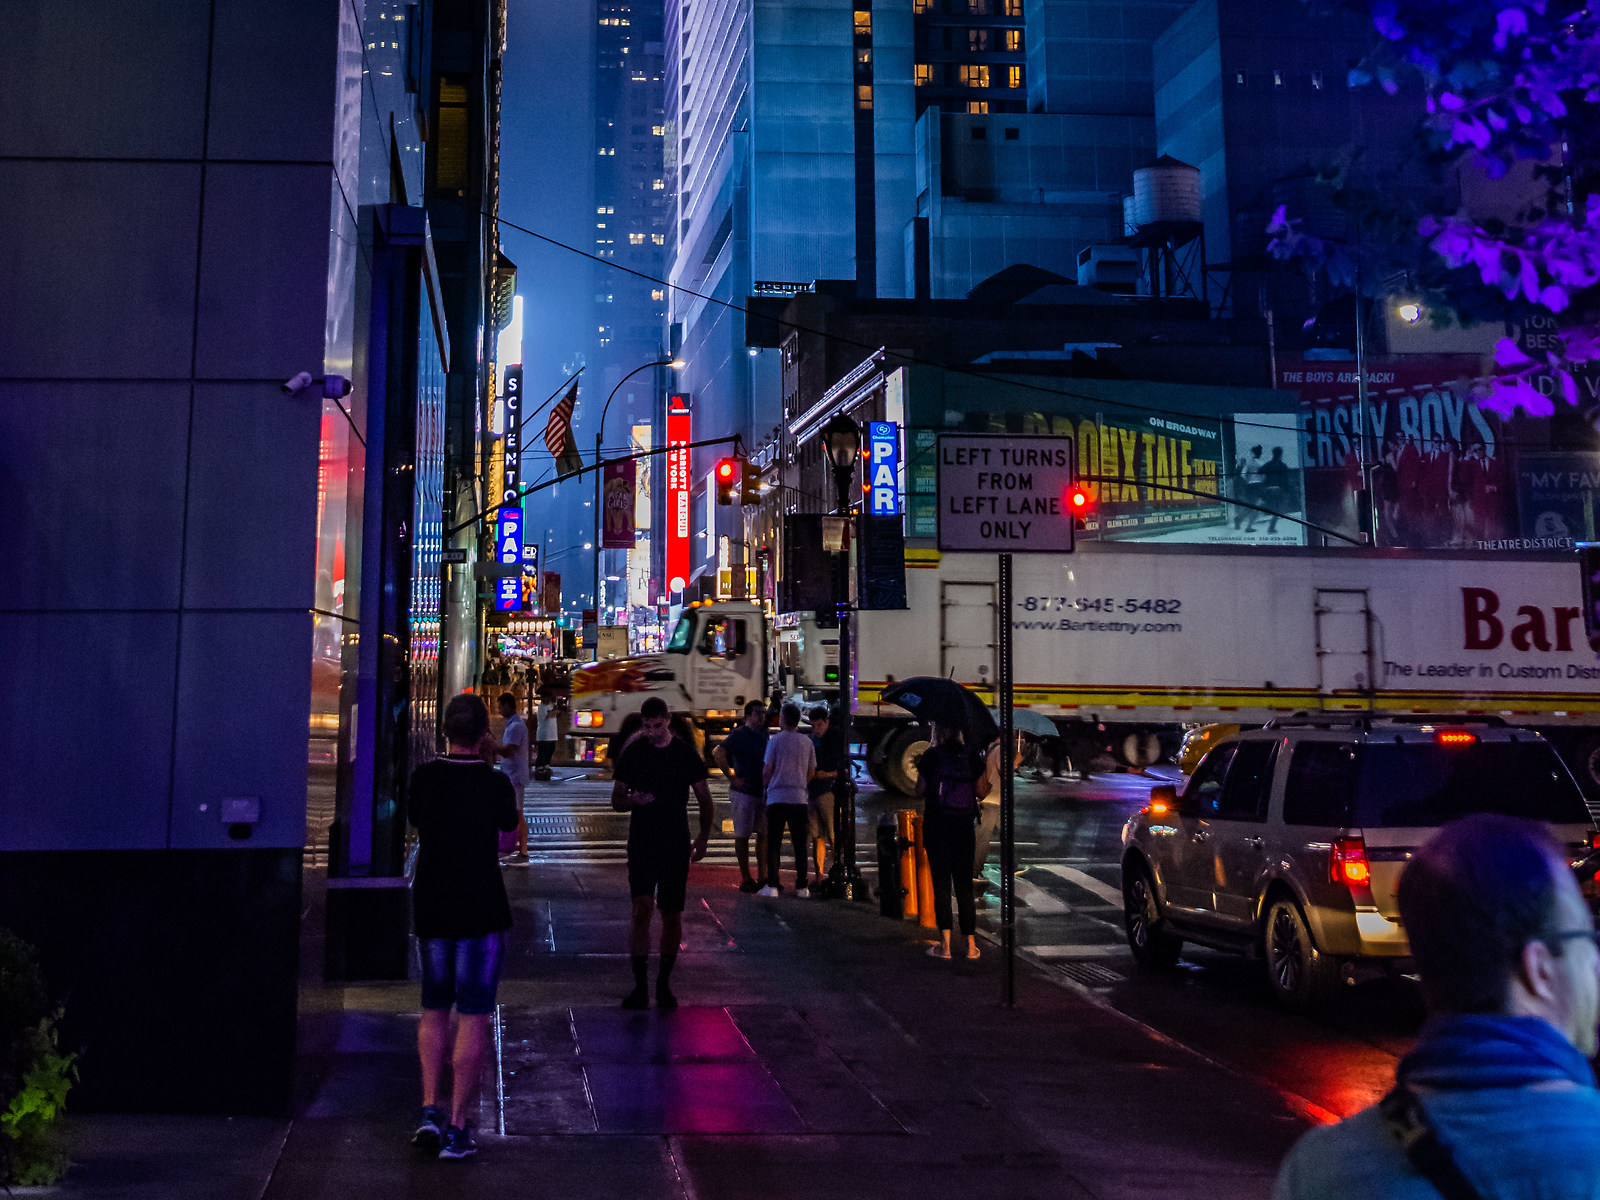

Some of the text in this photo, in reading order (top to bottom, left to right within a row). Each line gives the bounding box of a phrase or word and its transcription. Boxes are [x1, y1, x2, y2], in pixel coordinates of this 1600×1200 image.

[1283, 372, 1303, 383] THE
[1306, 372, 1333, 383] BOYS
[1367, 373, 1395, 383] ACK!
[1149, 416, 1217, 440] ON BROADWAY
[1400, 391, 1495, 461] BOYS
[943, 447, 1067, 467] LEFT TURNS
[1141, 432, 1194, 501] TALE
[873, 441, 895, 514] PAR
[978, 472, 1033, 490] FROM
[950, 496, 1060, 515] LEFT LANE
[980, 520, 1032, 539] ONLY
[1477, 536, 1572, 550] THEATRE DISTRICT
[1461, 587, 1600, 652] Bar
[1383, 661, 1412, 676] The
[1417, 662, 1475, 677] Leader
[1479, 663, 1493, 677] in
[1500, 662, 1562, 678] Custom
